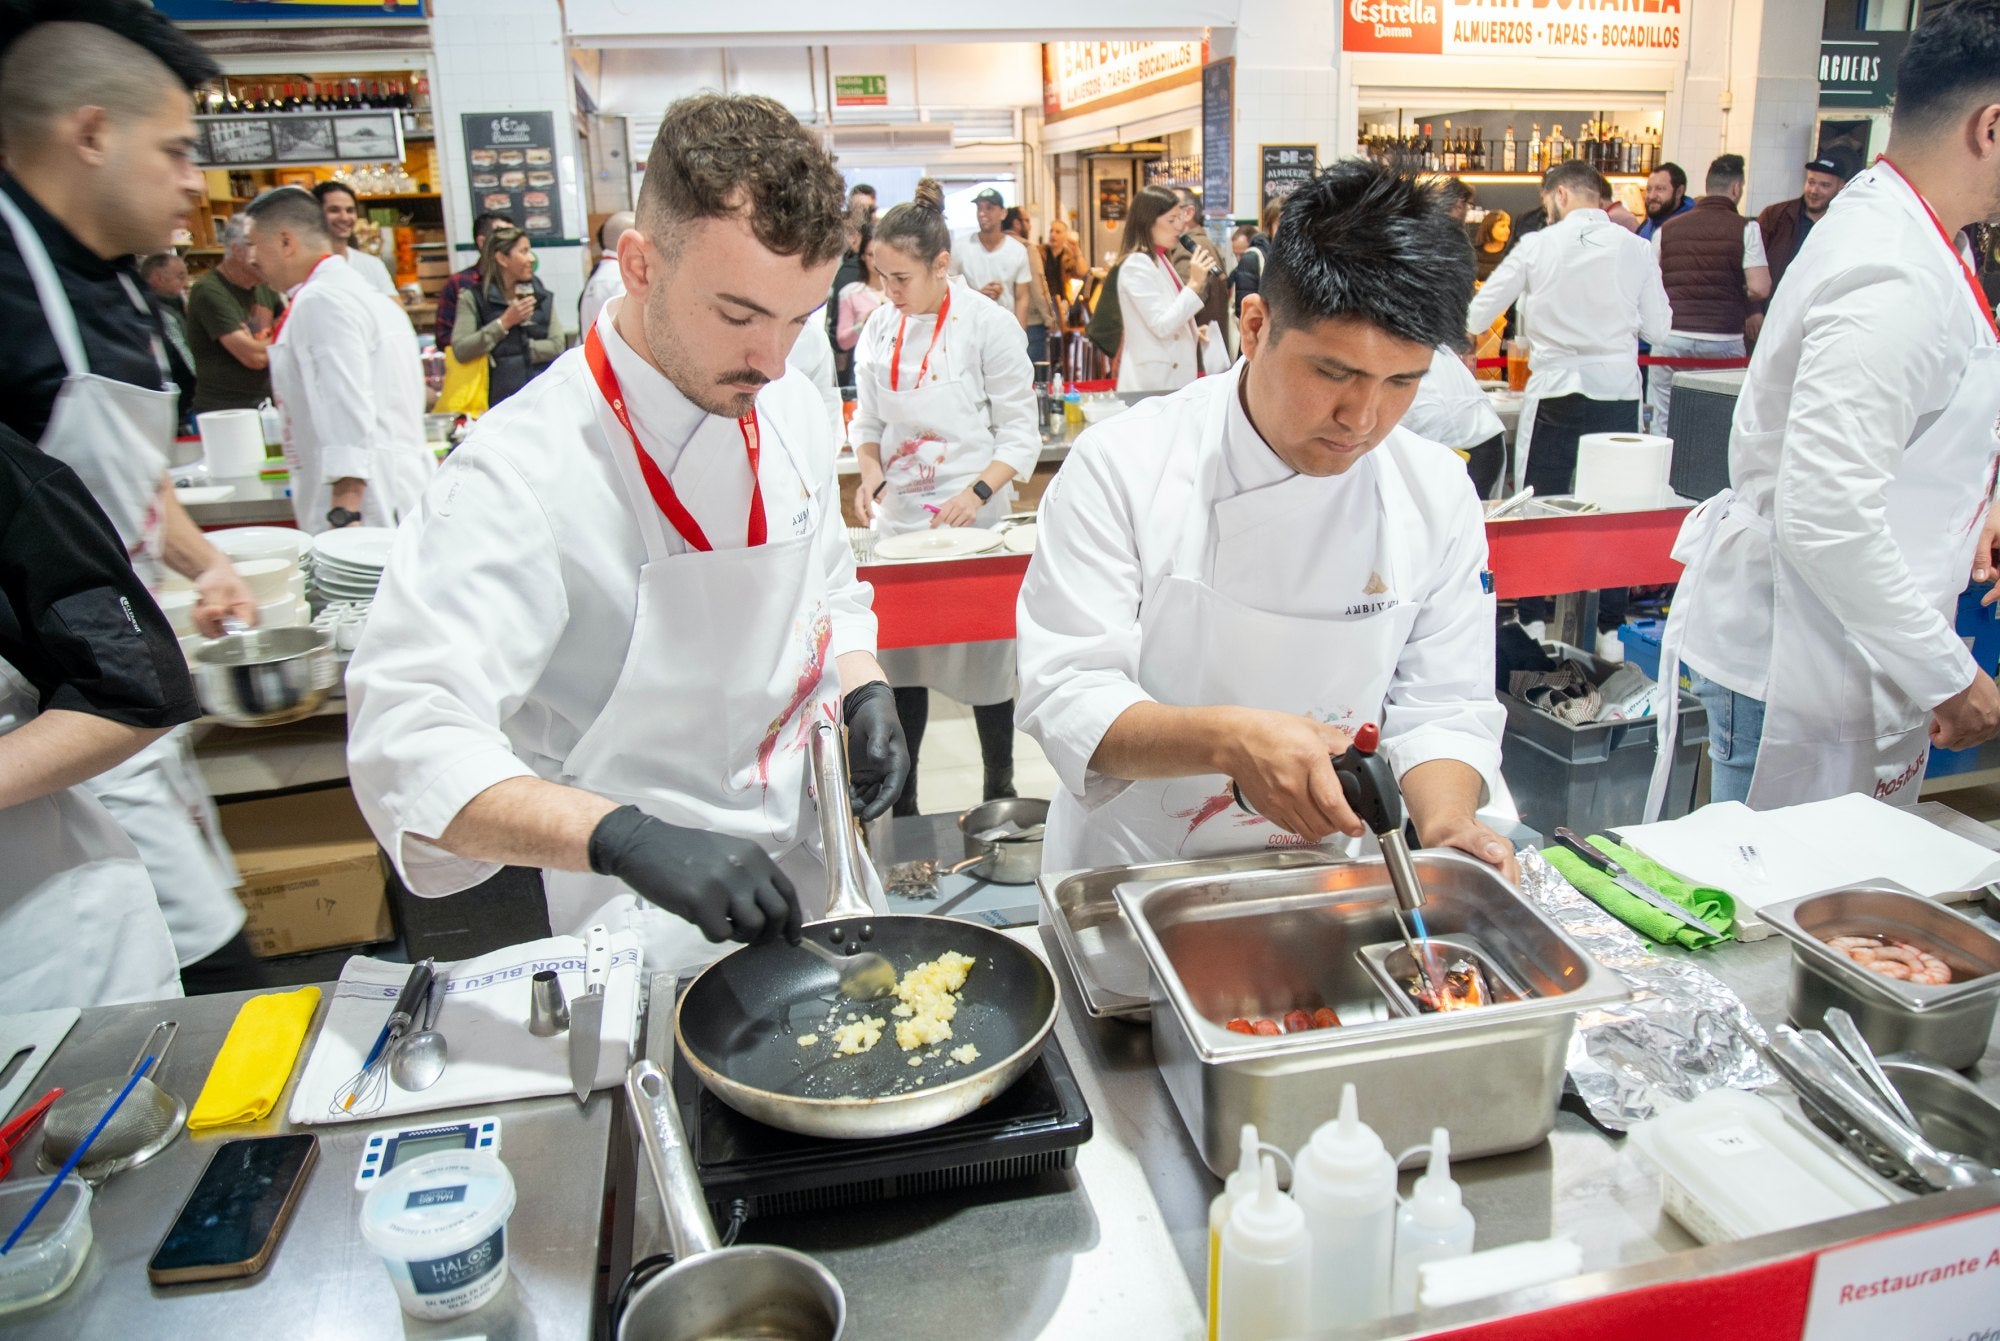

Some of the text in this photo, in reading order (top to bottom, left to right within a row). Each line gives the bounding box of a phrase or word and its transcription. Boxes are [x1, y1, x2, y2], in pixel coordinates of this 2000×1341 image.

[1350, 0, 1437, 24] Estrella
[1374, 24, 1413, 39] Damm
[1453, 20, 1681, 49] ALMUERZOS TAPAS BOCADILLOS
[1067, 77, 1102, 103] ALMUERZOS
[1107, 65, 1132, 89] TAPAS
[1138, 43, 1192, 80] BOCADILLOS
[1279, 150, 1299, 165] DE
[531, 954, 620, 974] CRDON
[465, 966, 523, 991] BLEU
[431, 1241, 492, 1279] HALOS
[1838, 1256, 1981, 1306] Restaurante
